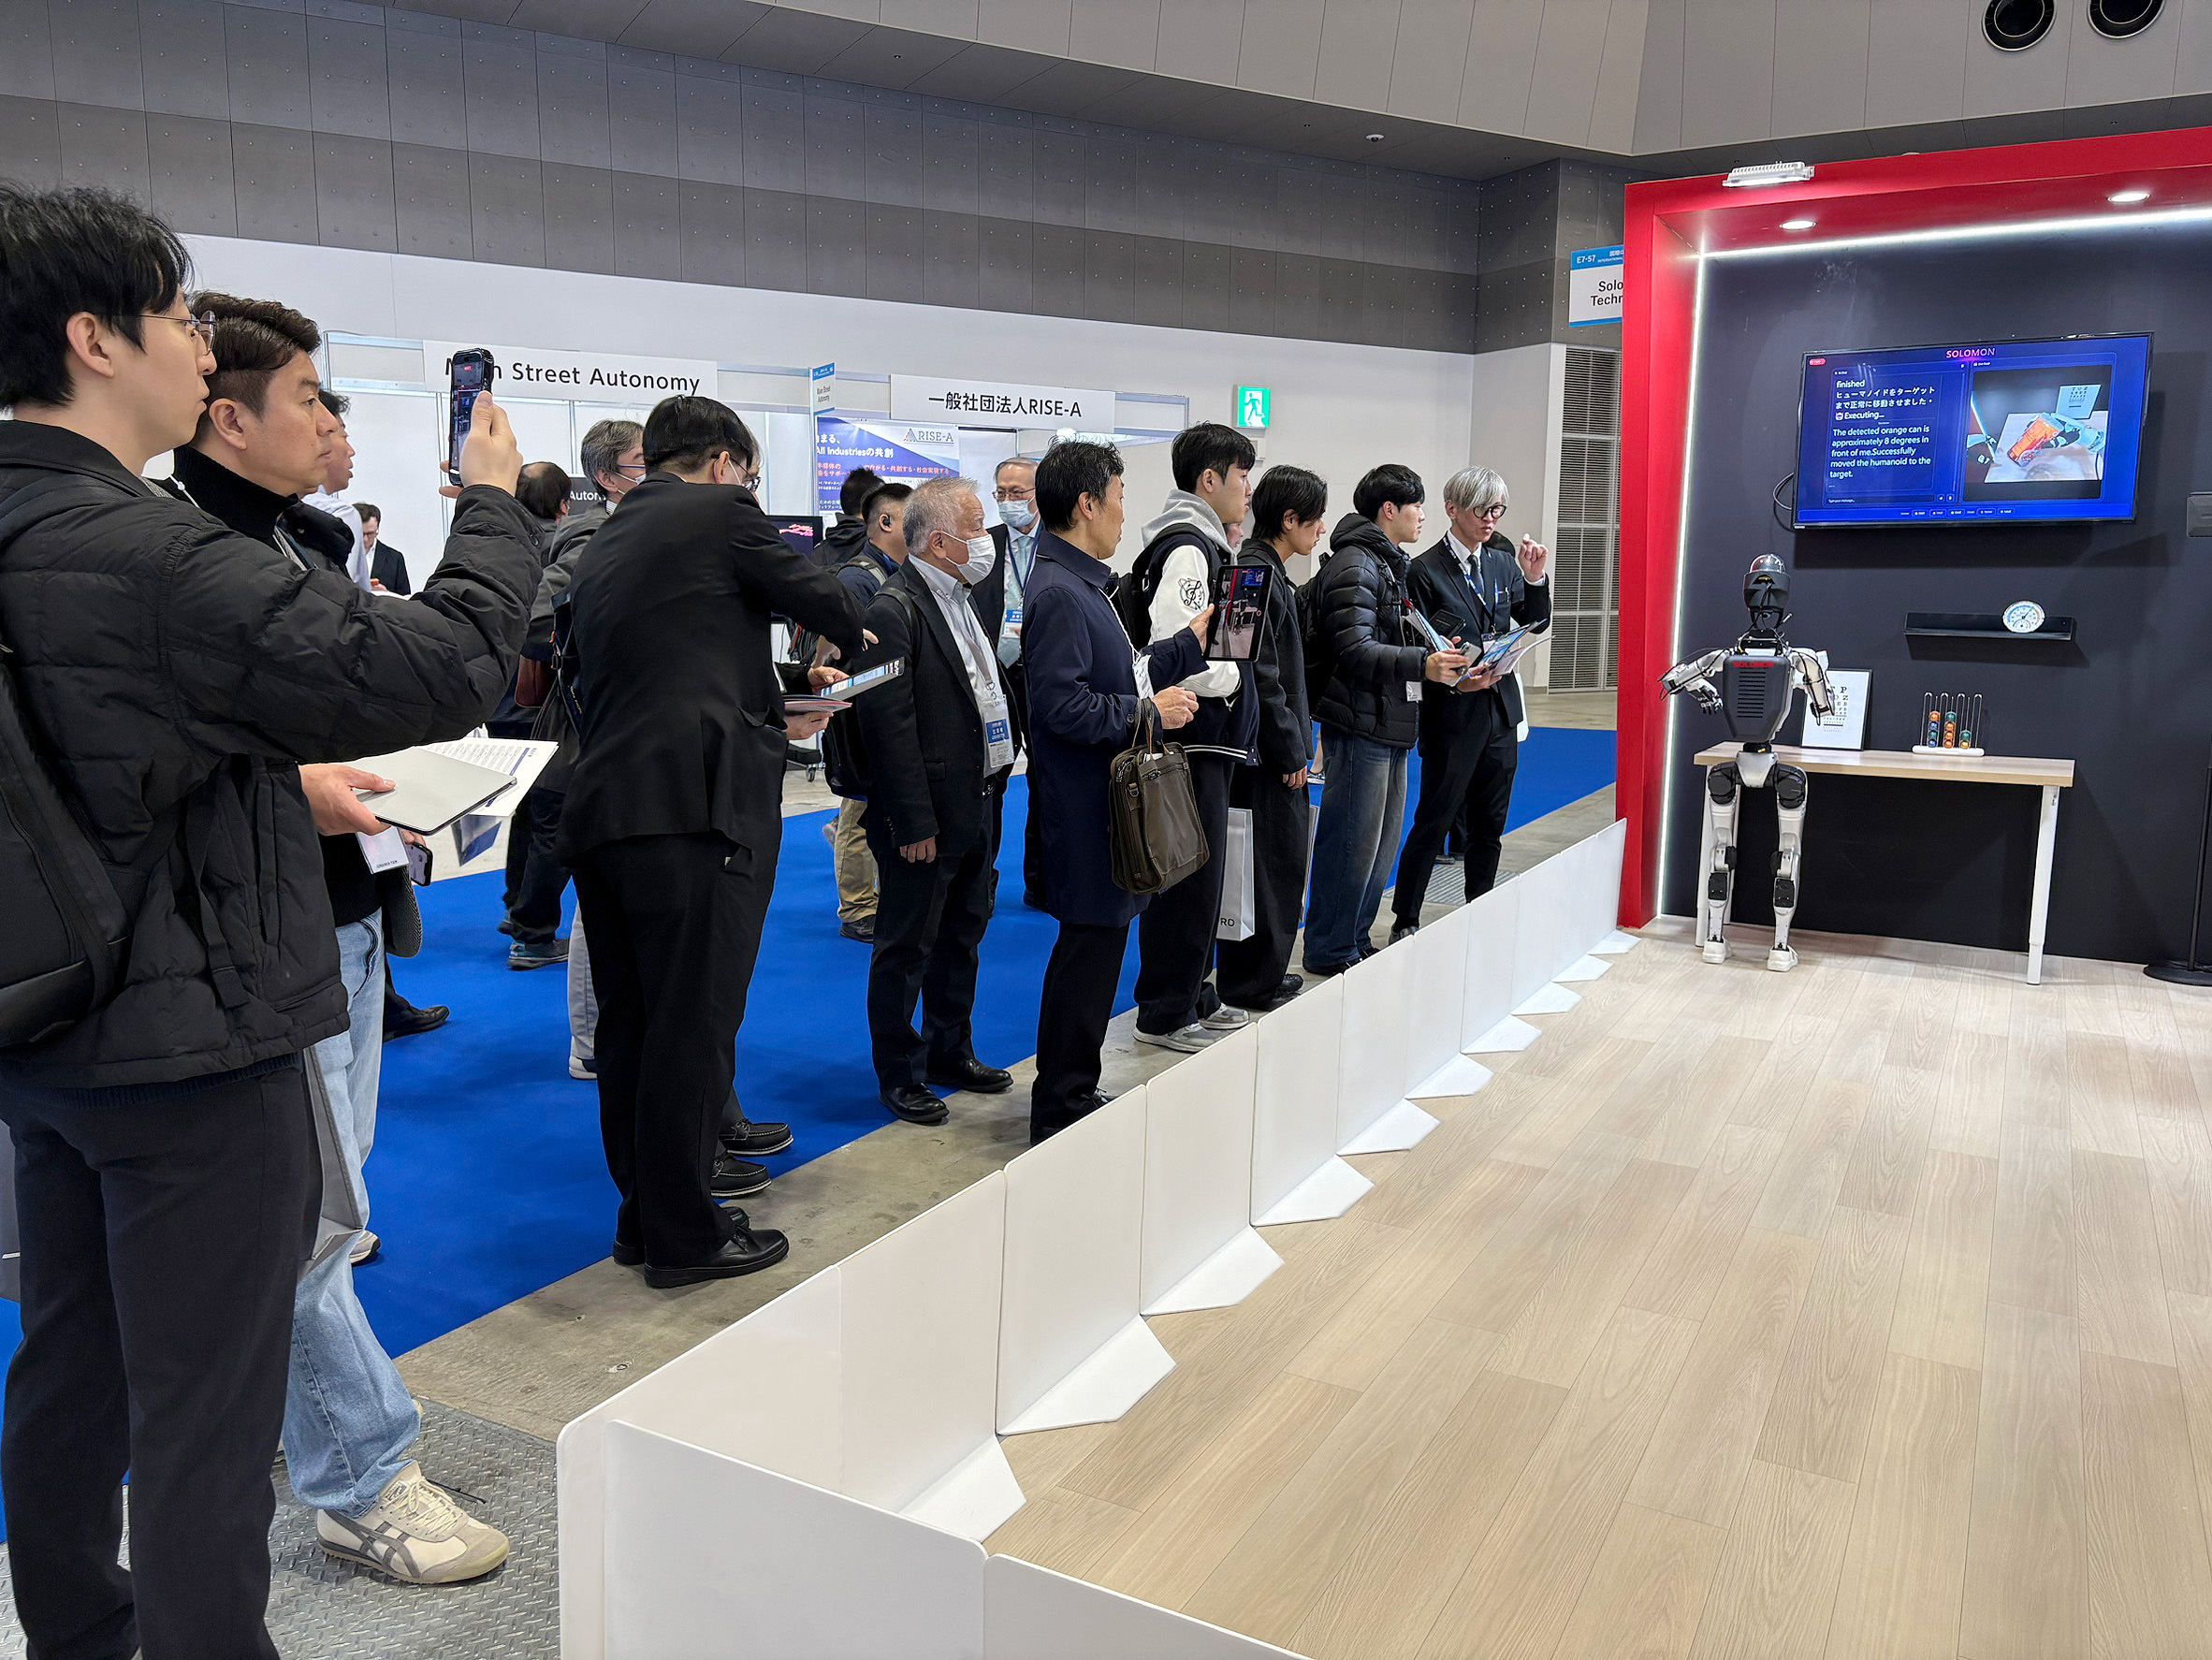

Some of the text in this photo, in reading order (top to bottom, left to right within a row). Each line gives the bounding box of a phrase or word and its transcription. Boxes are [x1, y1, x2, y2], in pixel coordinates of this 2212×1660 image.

[1946, 348, 1995, 358] SOLOMON
[512, 363, 580, 384] Street
[589, 368, 700, 396] Autonomy
[1836, 380, 1865, 388] finished
[1836, 386, 1935, 399] ヒューマノイドをターゲット
[928, 391, 1082, 417] 一般社団法人RISE-A
[919, 430, 954, 442] RISE-A
[1847, 427, 1879, 436] detected
[1881, 428, 1907, 436] orange
[1832, 438, 1883, 448] approximately
[1890, 436, 1920, 446] degrees
[1851, 448, 1858, 457] of
[1830, 459, 1855, 468] moved
[1870, 458, 1907, 466] humanoid
[1918, 457, 1931, 465] the
[1830, 470, 1853, 479] target.
